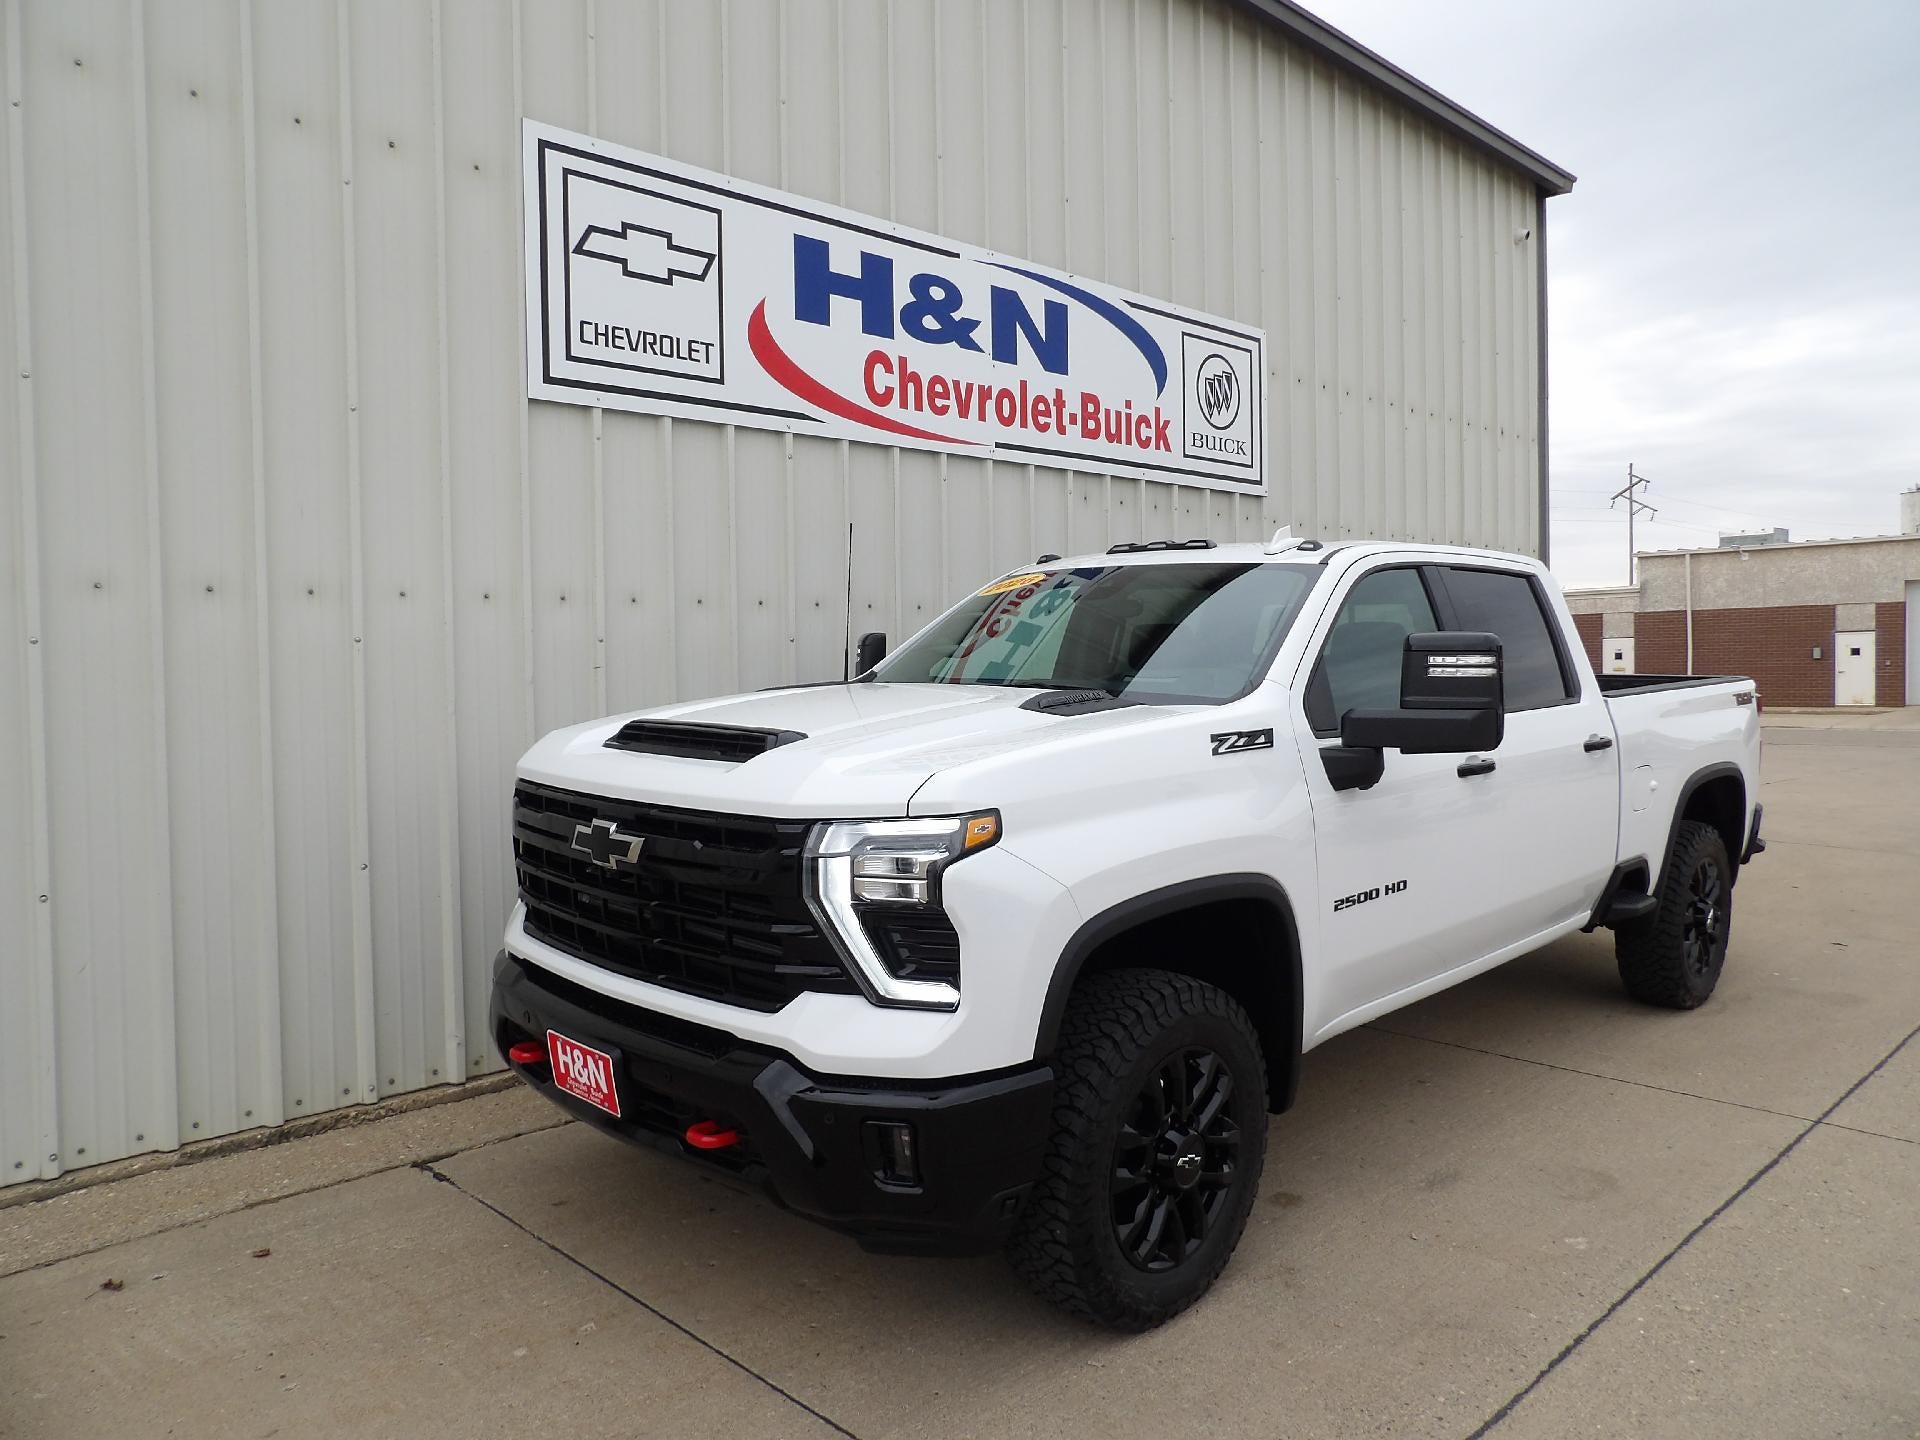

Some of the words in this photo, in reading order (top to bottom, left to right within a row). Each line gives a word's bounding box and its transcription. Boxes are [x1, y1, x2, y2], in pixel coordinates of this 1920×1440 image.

[793, 233, 1069, 376] H&N
[579, 319, 715, 364] CHEVROLET
[863, 350, 1172, 453] Chevrolet-Buick
[1190, 431, 1248, 456] BUICK
[1333, 887, 1380, 912] 2500
[1384, 879, 1408, 896] HD
[556, 1040, 609, 1094] H&N
